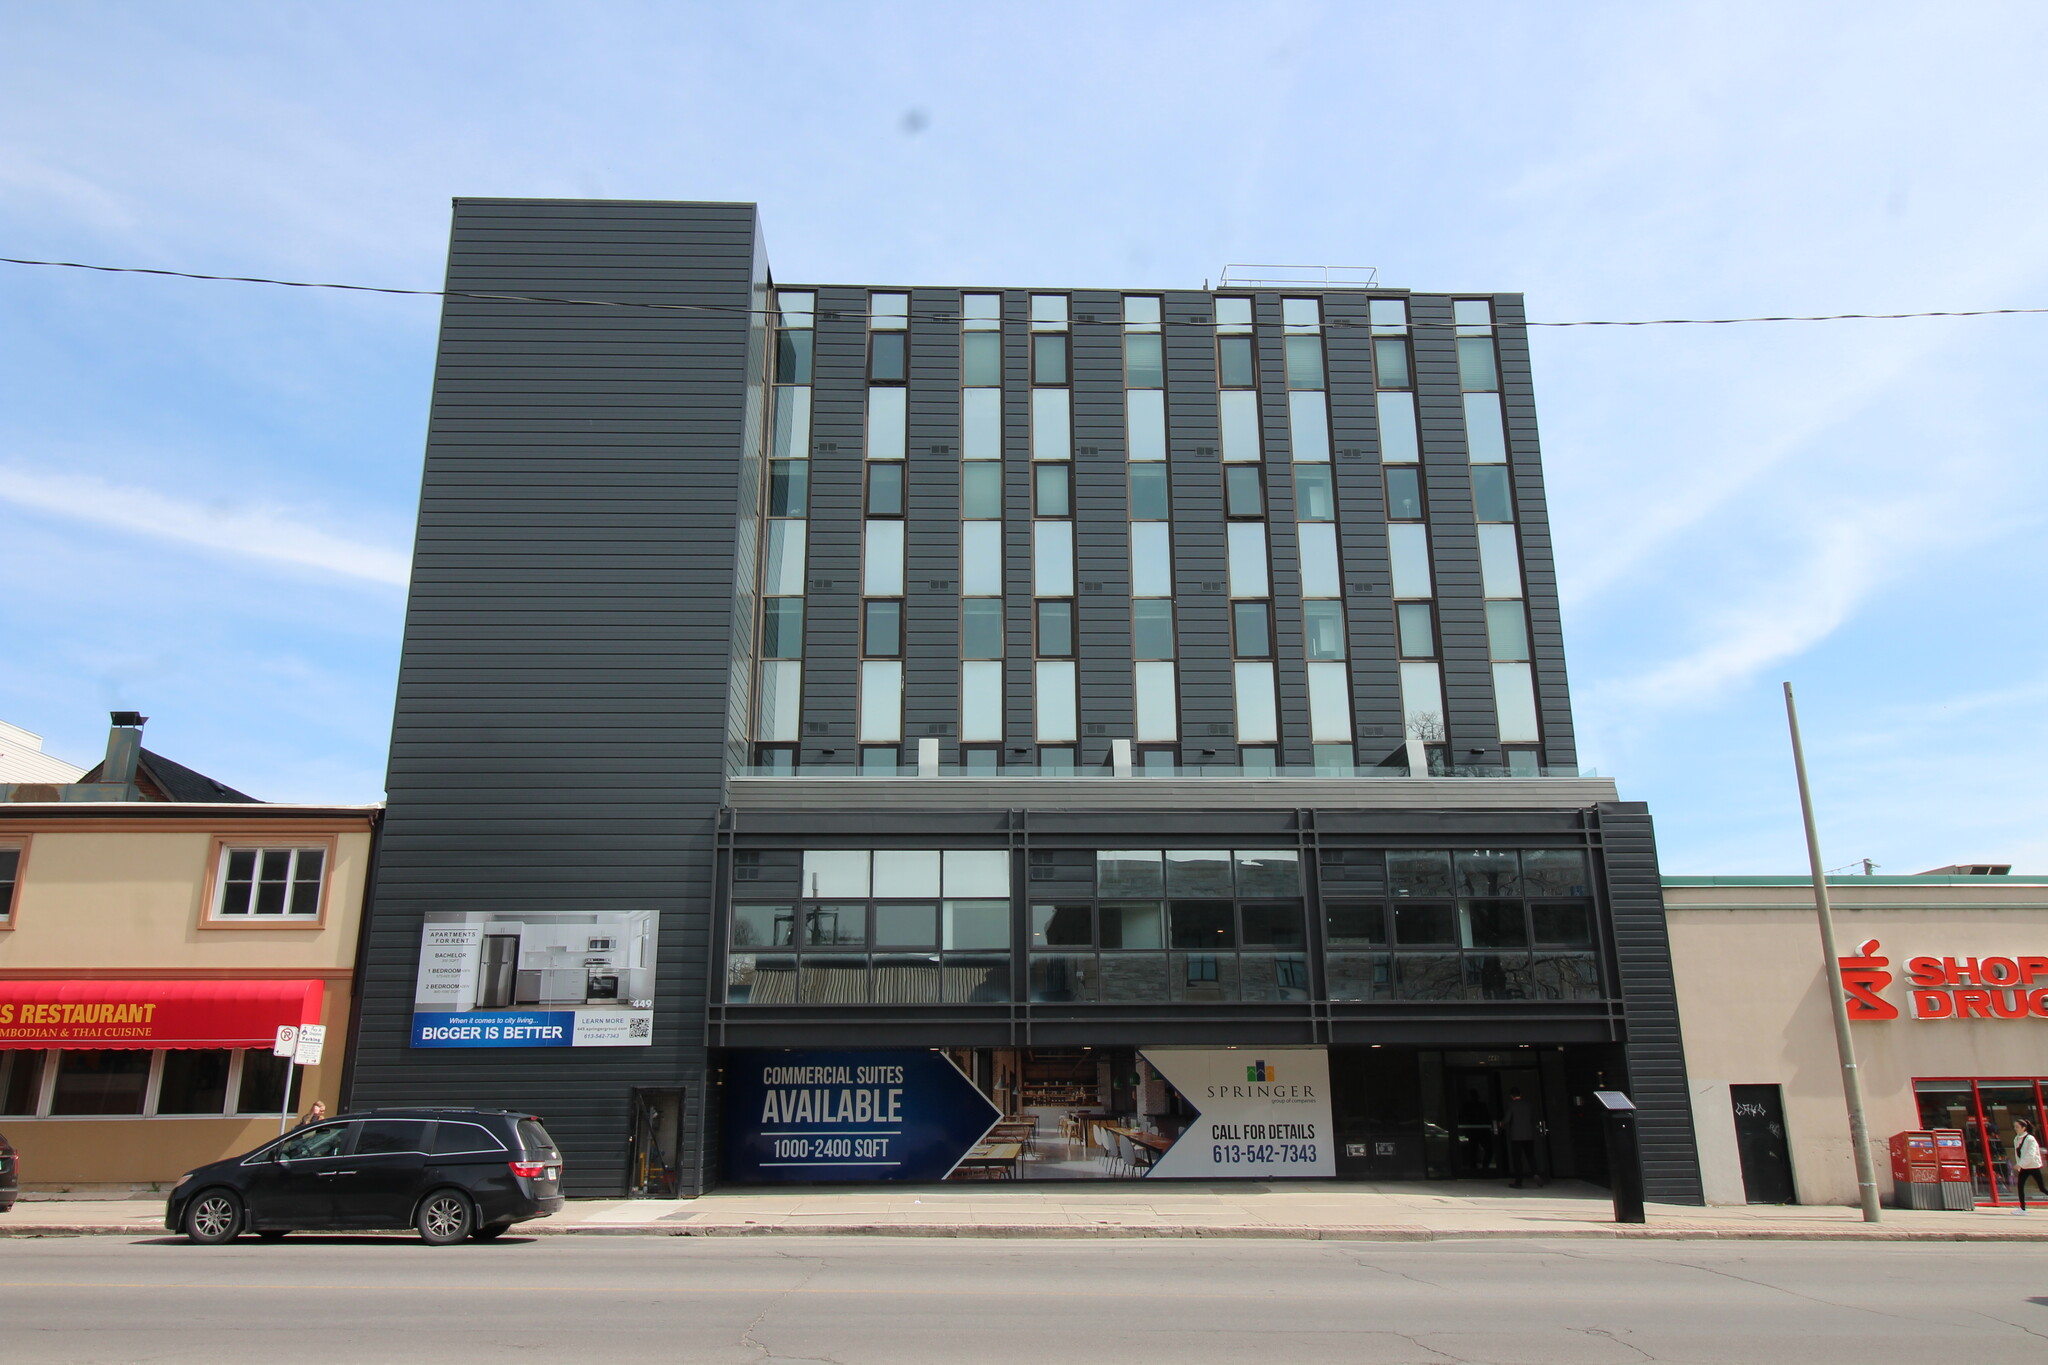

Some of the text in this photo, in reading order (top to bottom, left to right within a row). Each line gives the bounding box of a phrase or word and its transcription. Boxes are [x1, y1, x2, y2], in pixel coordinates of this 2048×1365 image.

[1904, 956, 2048, 986] SHOP
[0, 1004, 156, 1023] S RESTAURANT
[505, 1017, 516, 1025] city
[60, 1028, 69, 1037] &
[72, 1028, 101, 1037] THAI
[104, 1028, 152, 1037] CUISINE
[421, 1026, 563, 1039] BIGGER IS BETTER
[763, 1066, 904, 1085] COMMERCIAL SUITES
[1207, 1085, 1315, 1098] SPRINGER
[761, 1089, 903, 1123] AVAILABLE
[1212, 1124, 1315, 1140] CALL FOR DETAILS
[774, 1139, 889, 1158] 1000-2400 SQFT
[1213, 1144, 1317, 1163] 613-542-7343
